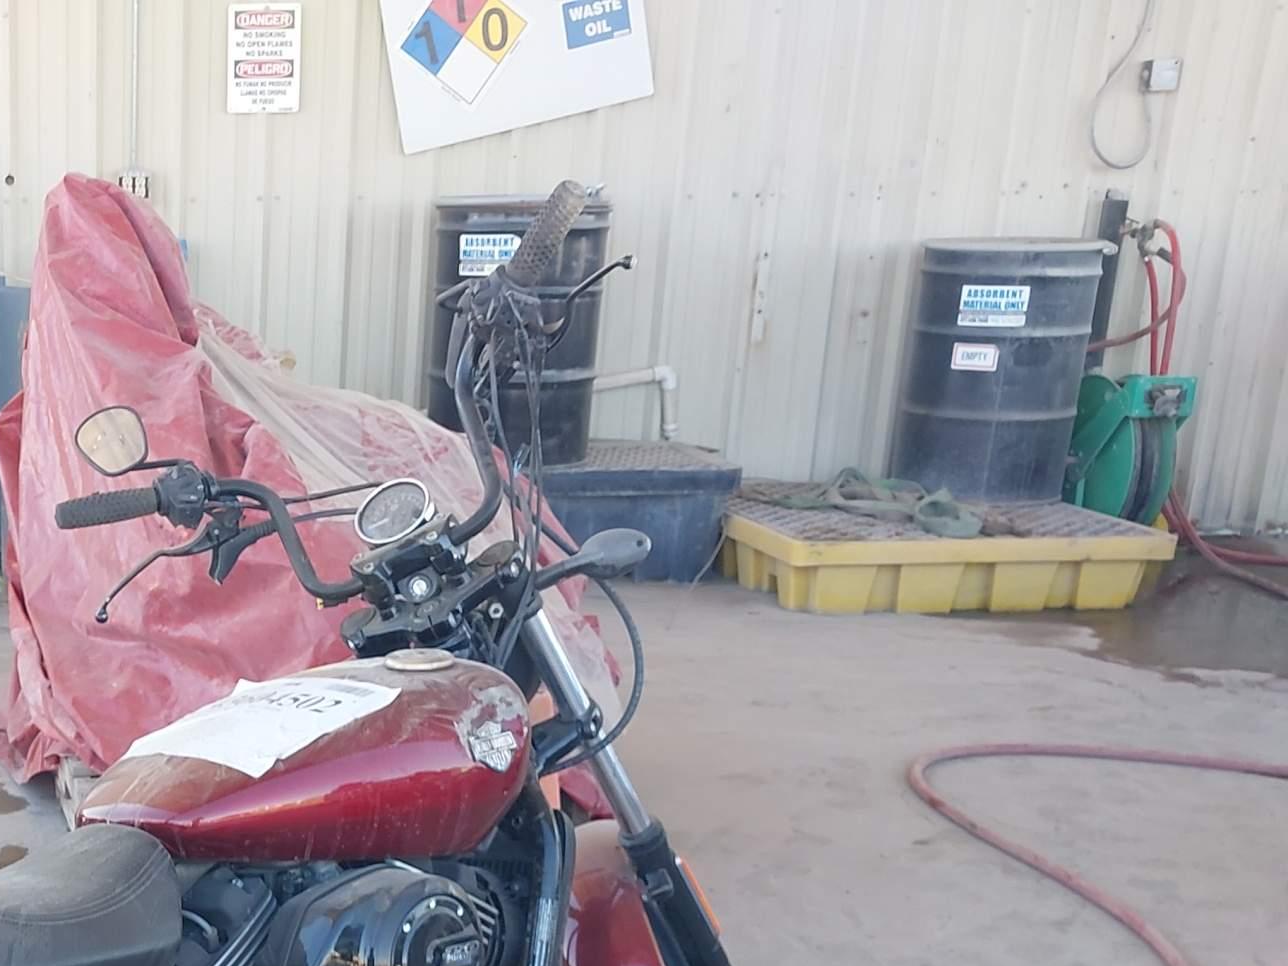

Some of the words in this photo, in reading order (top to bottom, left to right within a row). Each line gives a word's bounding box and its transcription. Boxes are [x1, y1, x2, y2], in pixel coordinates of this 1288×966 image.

[568, 0, 623, 21] WASTE
[241, 14, 290, 26] DANGER
[481, 7, 508, 51] 0
[584, 19, 612, 37] OIL
[415, 20, 439, 65] 1
[239, 63, 289, 75] PELIGRO
[966, 288, 1024, 298] ABSORBENT
[963, 300, 1001, 311] MATERIAL
[1004, 301, 1025, 311] ONLY
[961, 351, 988, 361] EMPTY
